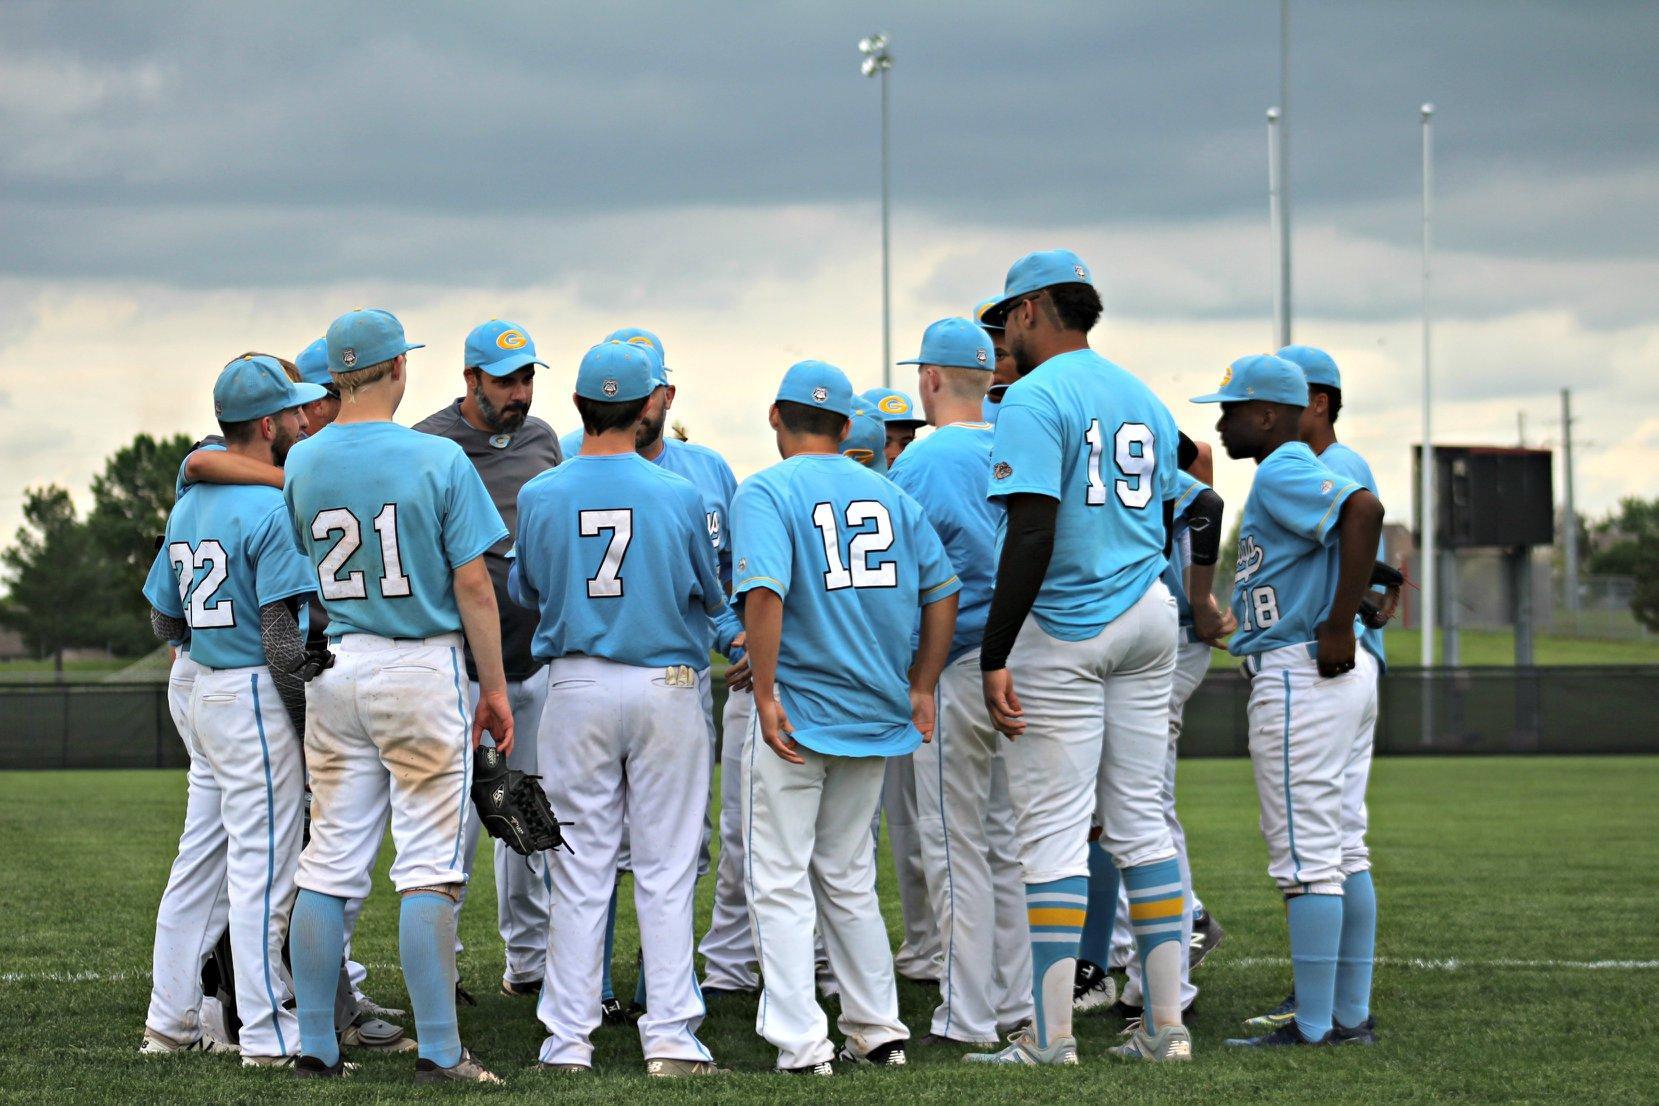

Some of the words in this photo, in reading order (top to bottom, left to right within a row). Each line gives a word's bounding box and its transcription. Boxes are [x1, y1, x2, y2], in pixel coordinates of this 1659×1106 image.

[496, 329, 528, 350] G
[878, 395, 909, 415] G
[1084, 418, 1156, 510] 19
[169, 539, 237, 629] 22
[311, 503, 413, 601] 21
[578, 508, 633, 598] 7
[811, 499, 898, 591] 12
[1241, 585, 1280, 632] 18
